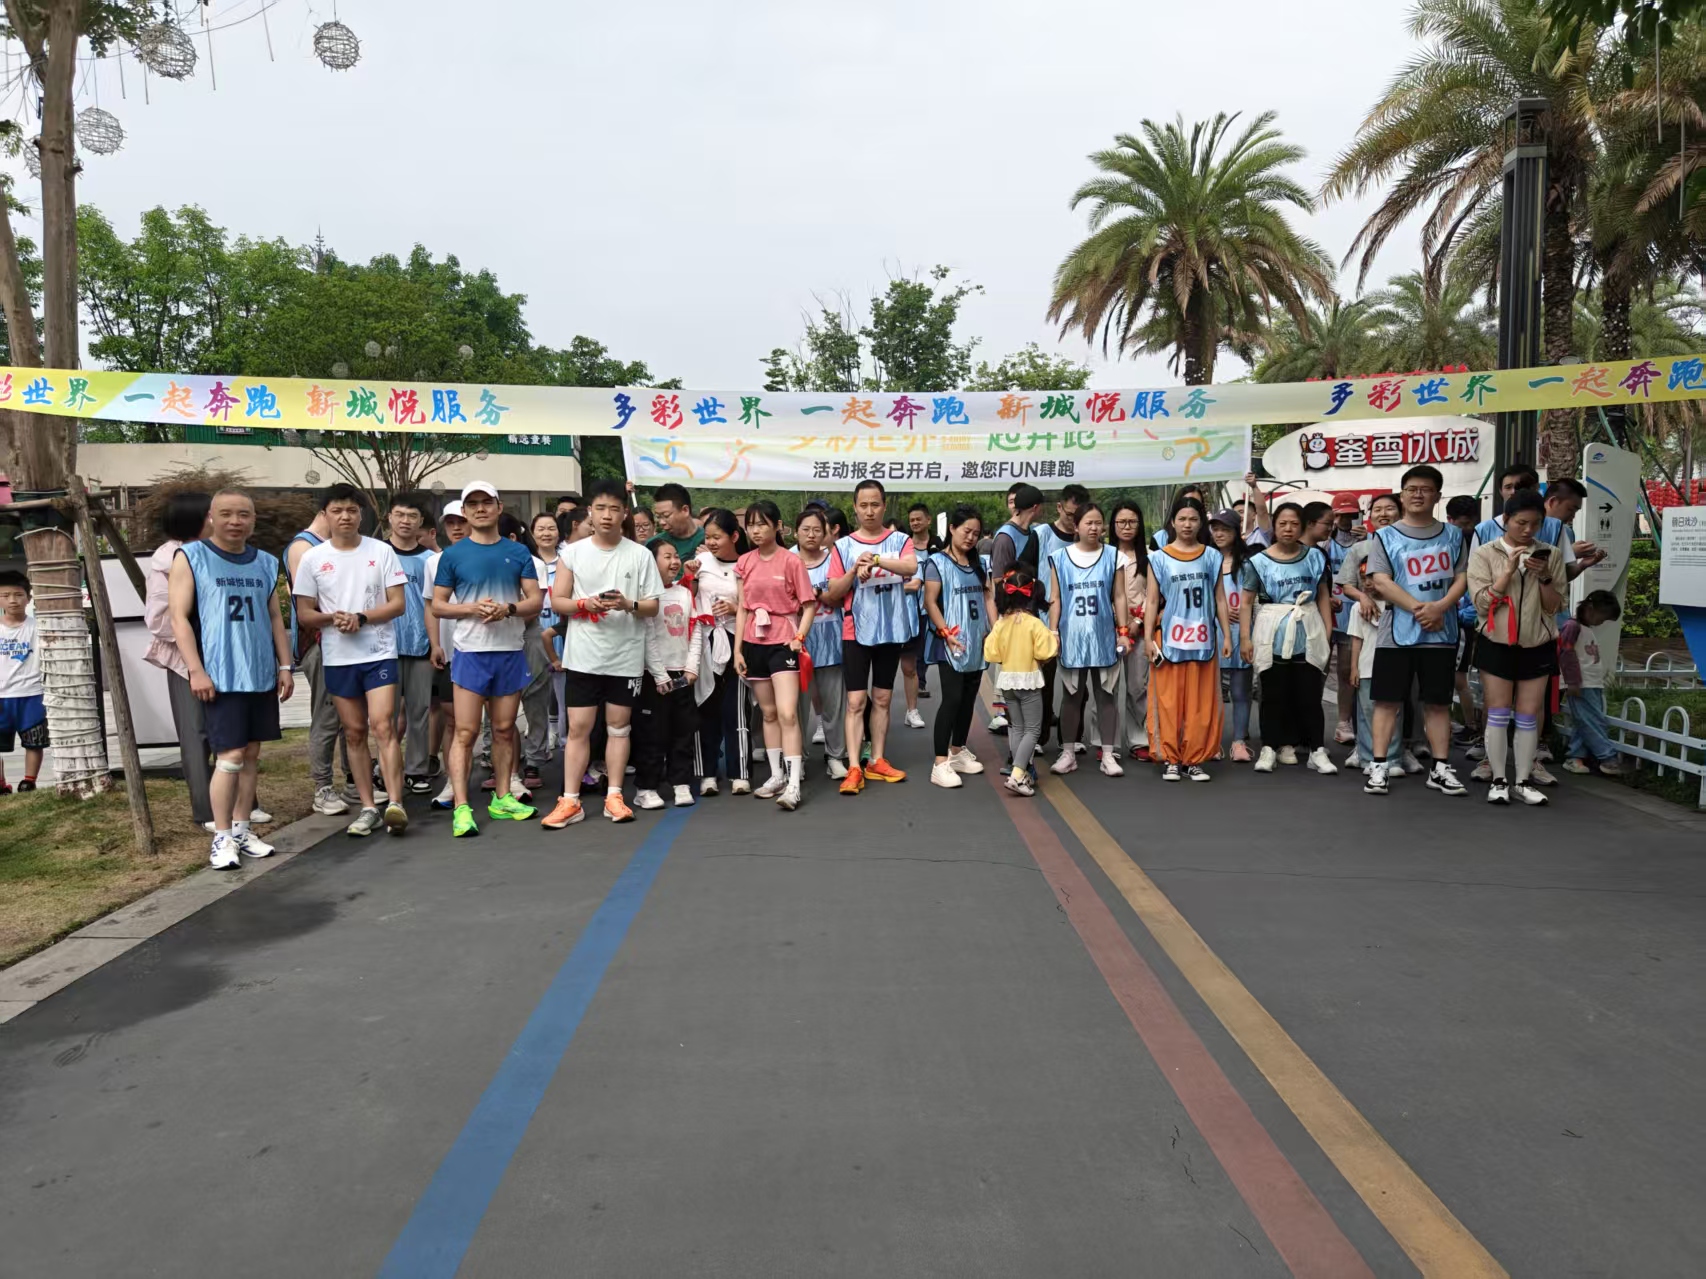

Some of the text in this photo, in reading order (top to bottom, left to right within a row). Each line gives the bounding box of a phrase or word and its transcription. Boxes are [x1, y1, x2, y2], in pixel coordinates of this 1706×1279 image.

[124, 380, 281, 422] 一起奔跑
[306, 384, 510, 425] 新城悦服务
[612, 391, 773, 429] 多彩世界
[801, 396, 969, 429] 一起奔跑
[997, 388, 1217, 428] 新城悦服务
[1323, 374, 1497, 415] 多彩世界
[1528, 358, 1706, 397] 一起奔跑
[1334, 427, 1480, 467] 蜜雪冰城
[1407, 551, 1450, 577] 020
[216, 577, 263, 588] 新城悦服务
[229, 595, 255, 622] 21
[1075, 595, 1098, 616] 39
[1183, 587, 1203, 609] 18
[969, 600, 979, 620] 6
[1172, 624, 1209, 643] 028
